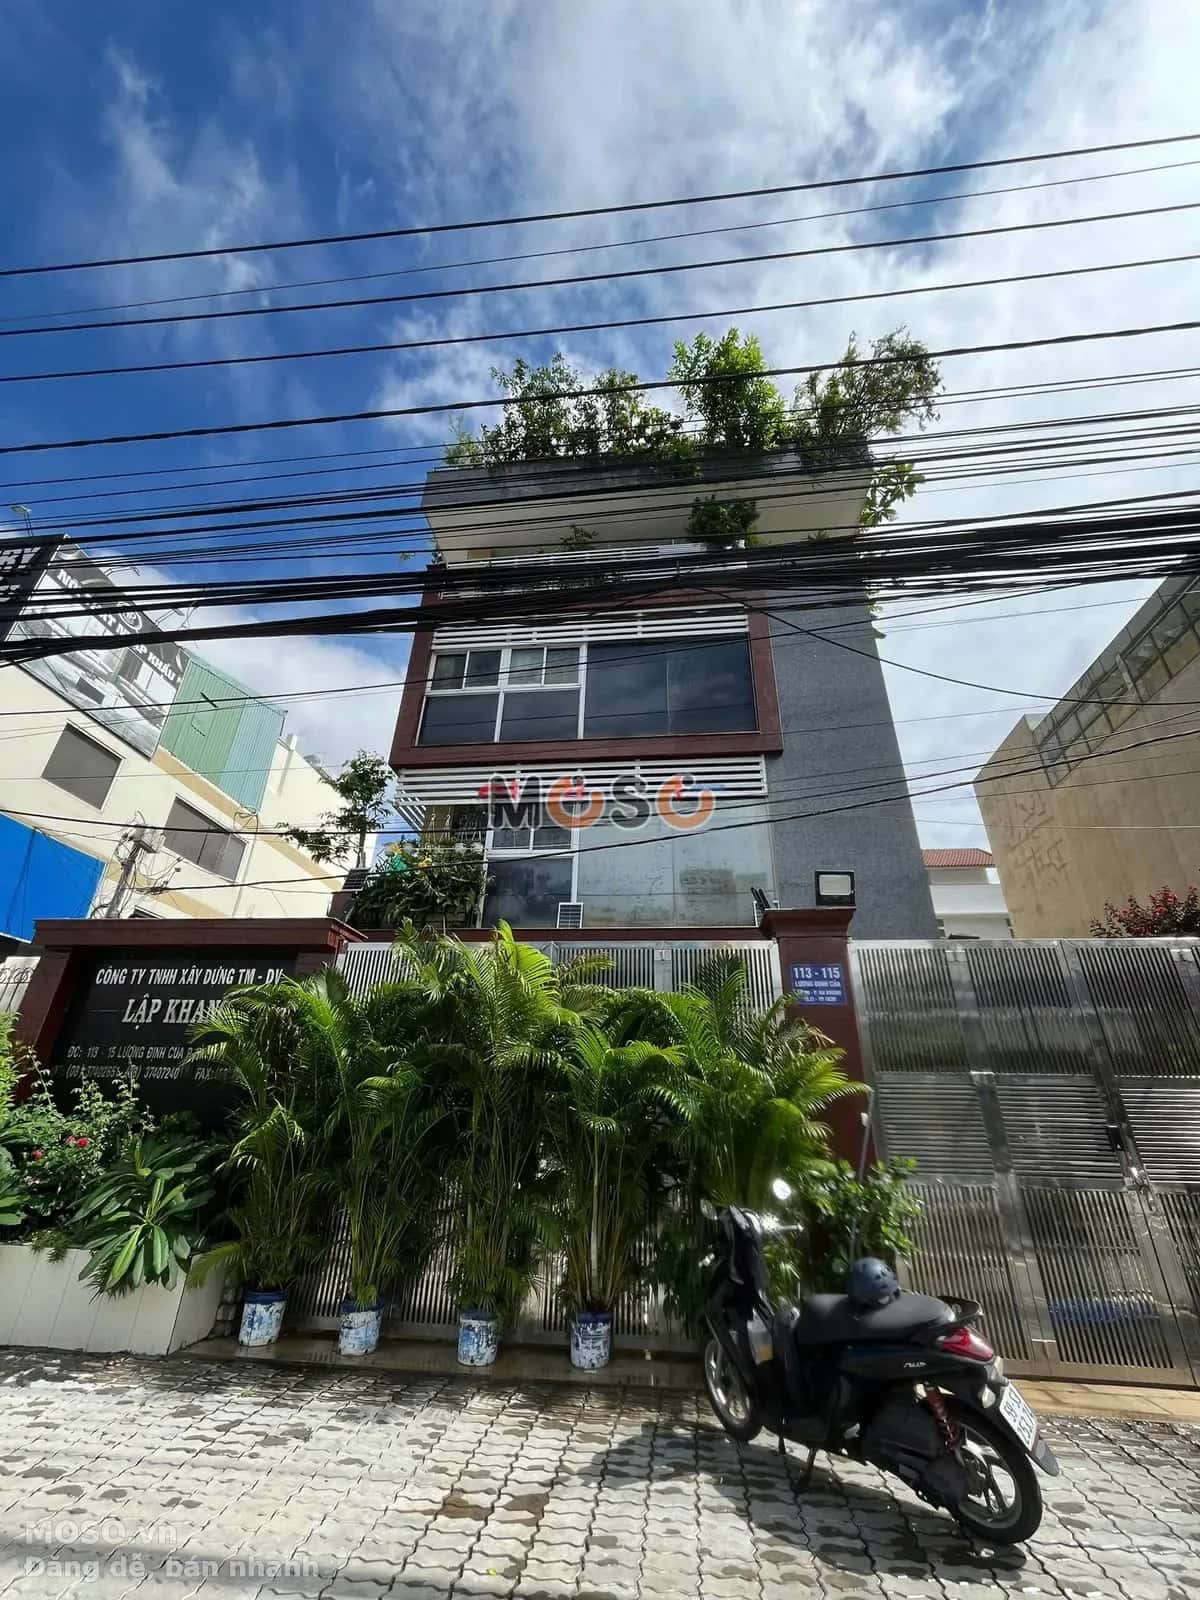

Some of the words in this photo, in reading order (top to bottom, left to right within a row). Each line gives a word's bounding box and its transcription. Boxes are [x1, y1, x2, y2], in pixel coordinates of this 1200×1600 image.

[96, 965, 127, 984] CÔNG
[130, 968, 146, 984] TY
[148, 968, 178, 984] TNHH
[178, 965, 203, 984] XÂY
[239, 968, 256, 984] TM
[266, 968, 283, 985] DV
[794, 967, 812, 979] 113
[821, 967, 840, 979] 115
[121, 993, 161, 1030] LẬP
